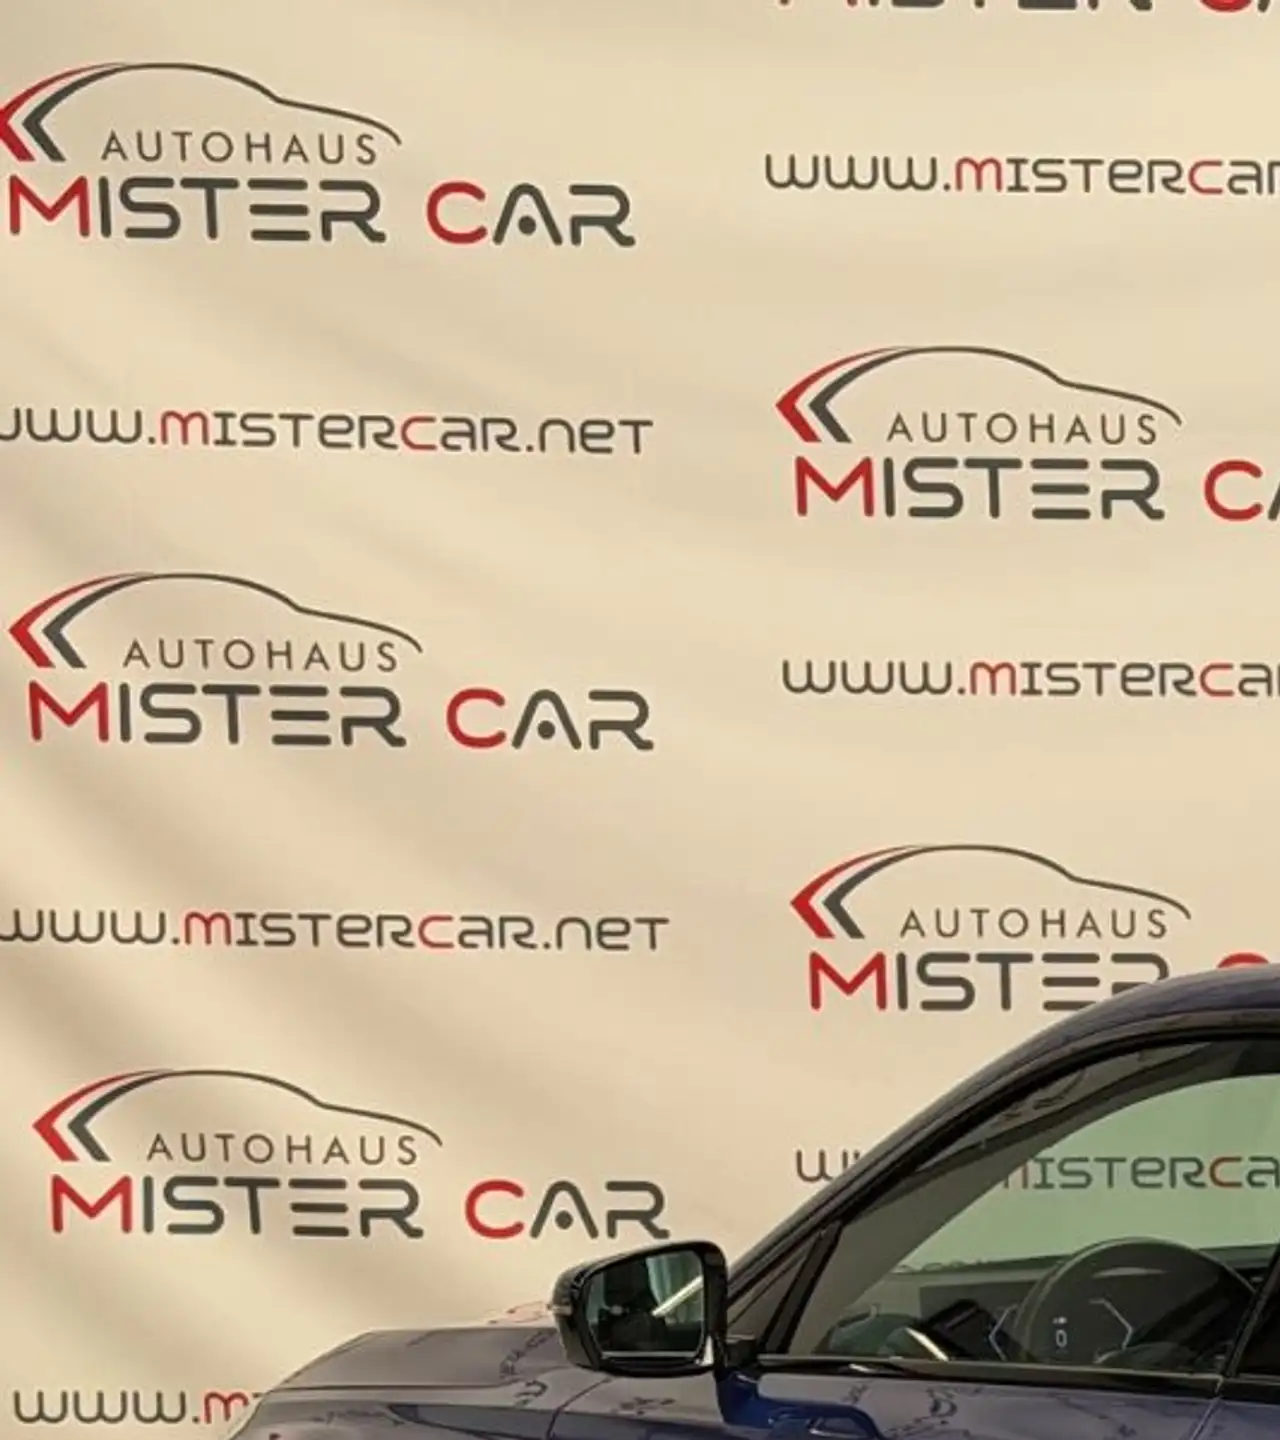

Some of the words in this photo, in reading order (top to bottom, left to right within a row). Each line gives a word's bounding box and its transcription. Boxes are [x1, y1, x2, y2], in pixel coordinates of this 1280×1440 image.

[100, 131, 379, 167] AUTOHAUS
[8, 174, 387, 244] MISTER
[426, 181, 636, 248] CAR
[886, 412, 1158, 446] AUTOHAUS
[794, 455, 1165, 521] MISTER
[122, 639, 399, 673] AUTOHAUS
[28, 679, 407, 748] MISTER
[446, 687, 654, 751] CAR
[899, 908, 1167, 940] AUTOHAUS
[146, 1132, 417, 1166] AUTOHAUS
[50, 1174, 424, 1239] MISTER
[464, 1179, 671, 1240] CAR
